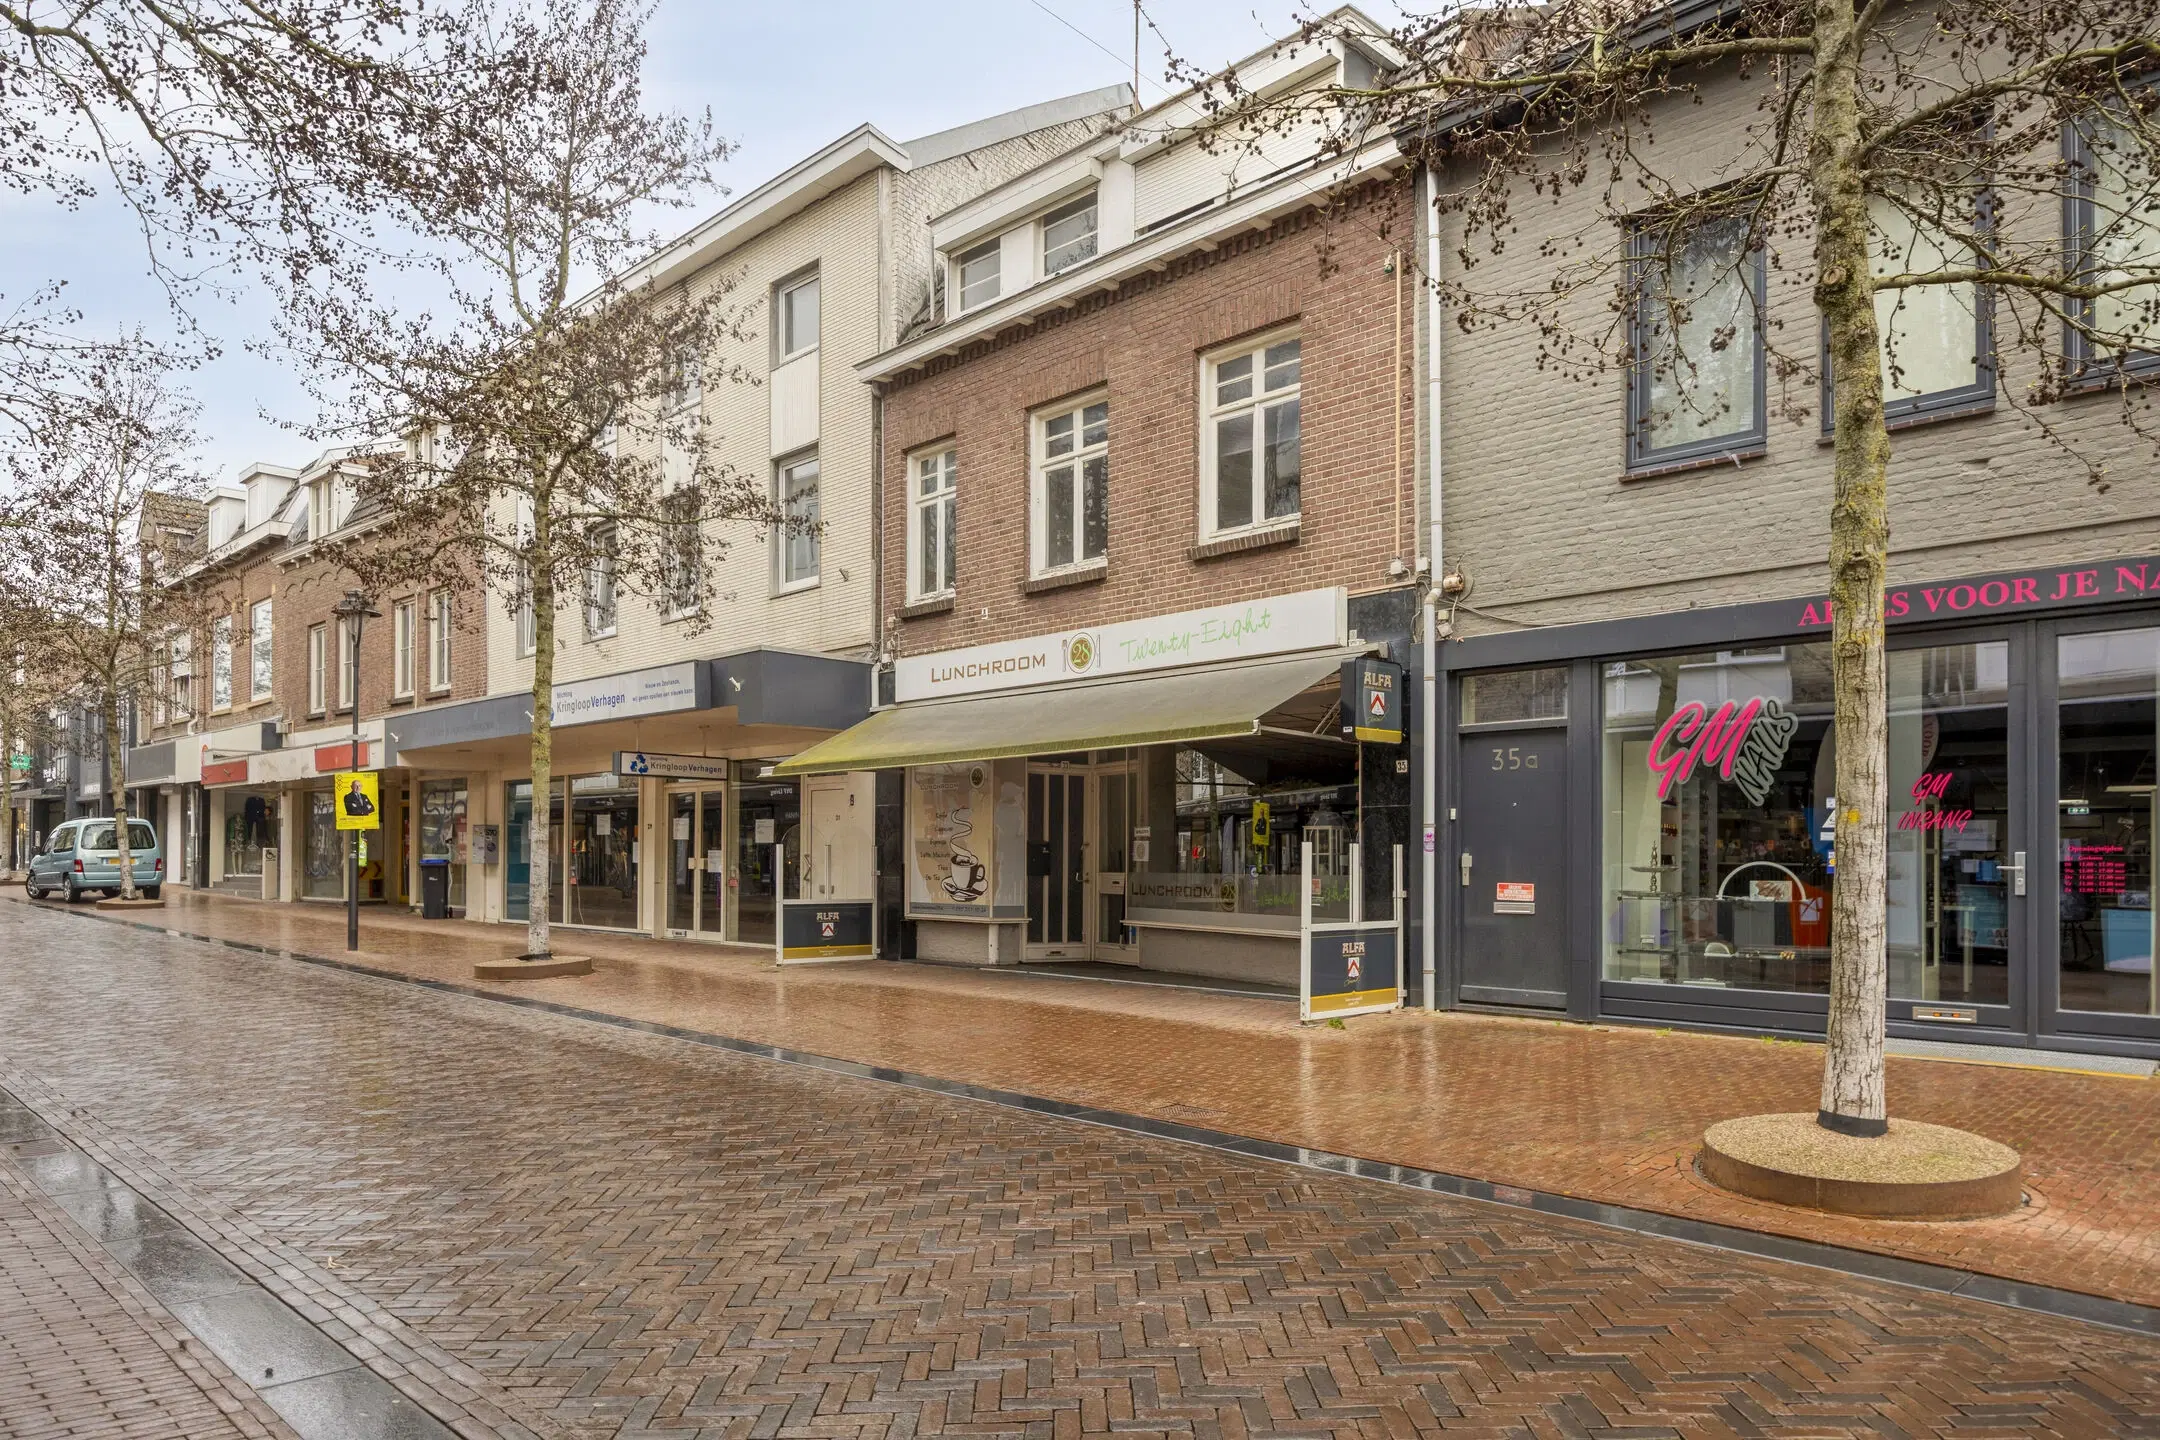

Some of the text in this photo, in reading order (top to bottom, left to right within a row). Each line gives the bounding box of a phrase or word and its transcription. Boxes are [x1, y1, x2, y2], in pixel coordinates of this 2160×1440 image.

[1797, 591, 1910, 628] ALS
[1920, 577, 2041, 613] VOOR
[2050, 570, 2100, 600] JE
[1119, 607, 1271, 663] Twenty-Eight
[1072, 642, 1093, 664] 28
[930, 653, 1046, 684] LUNCHROOM
[1363, 671, 1392, 688] ALFA
[1649, 697, 1761, 799] GM
[1733, 697, 1797, 805] NAILS
[1397, 761, 1407, 772] 35
[1911, 772, 1953, 806] GM
[1897, 809, 1973, 834] INGANG
[1131, 881, 1213, 897] LUNCHROOM
[816, 912, 839, 921] ALFA
[1342, 941, 1365, 954] ALFA
